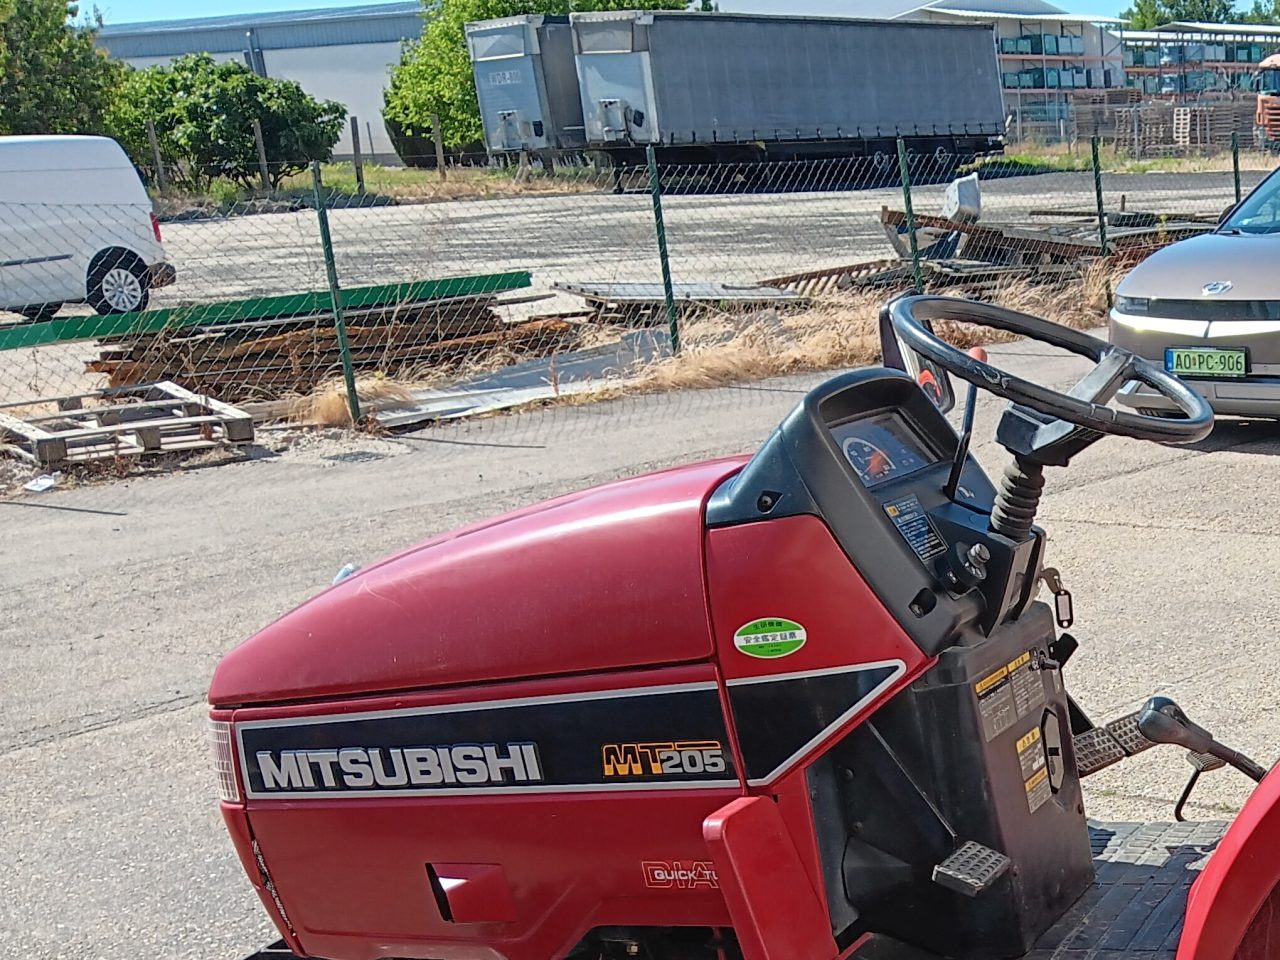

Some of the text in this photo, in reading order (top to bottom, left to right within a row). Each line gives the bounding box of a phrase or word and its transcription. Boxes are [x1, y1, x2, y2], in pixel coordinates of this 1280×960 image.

[256, 743, 542, 789] MITSUBISHI
[602, 741, 725, 776] MT205
[654, 870, 697, 880] QUICK
